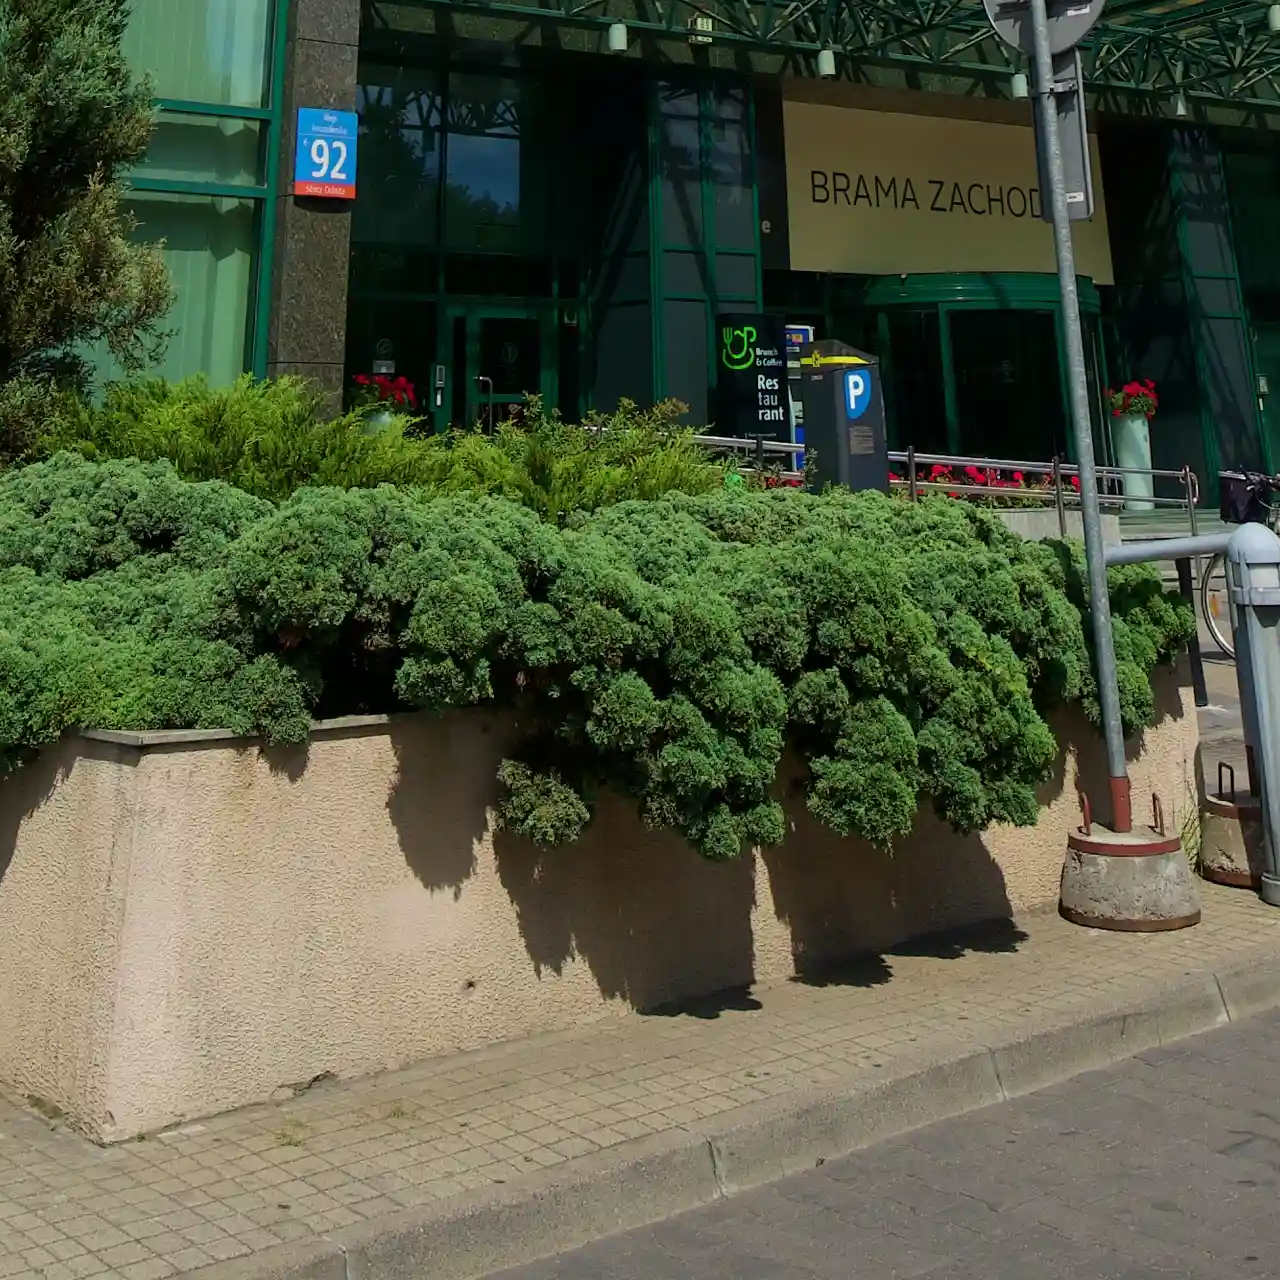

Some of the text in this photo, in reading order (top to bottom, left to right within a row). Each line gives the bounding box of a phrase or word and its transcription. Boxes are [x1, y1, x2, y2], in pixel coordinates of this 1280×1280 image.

[310, 138, 347, 180] 92
[810, 170, 1043, 219] BRAMA ZACHOD
[757, 374, 779, 390] Res
[847, 374, 865, 410] P
[758, 391, 778, 406] tau
[758, 406, 785, 421] rant
